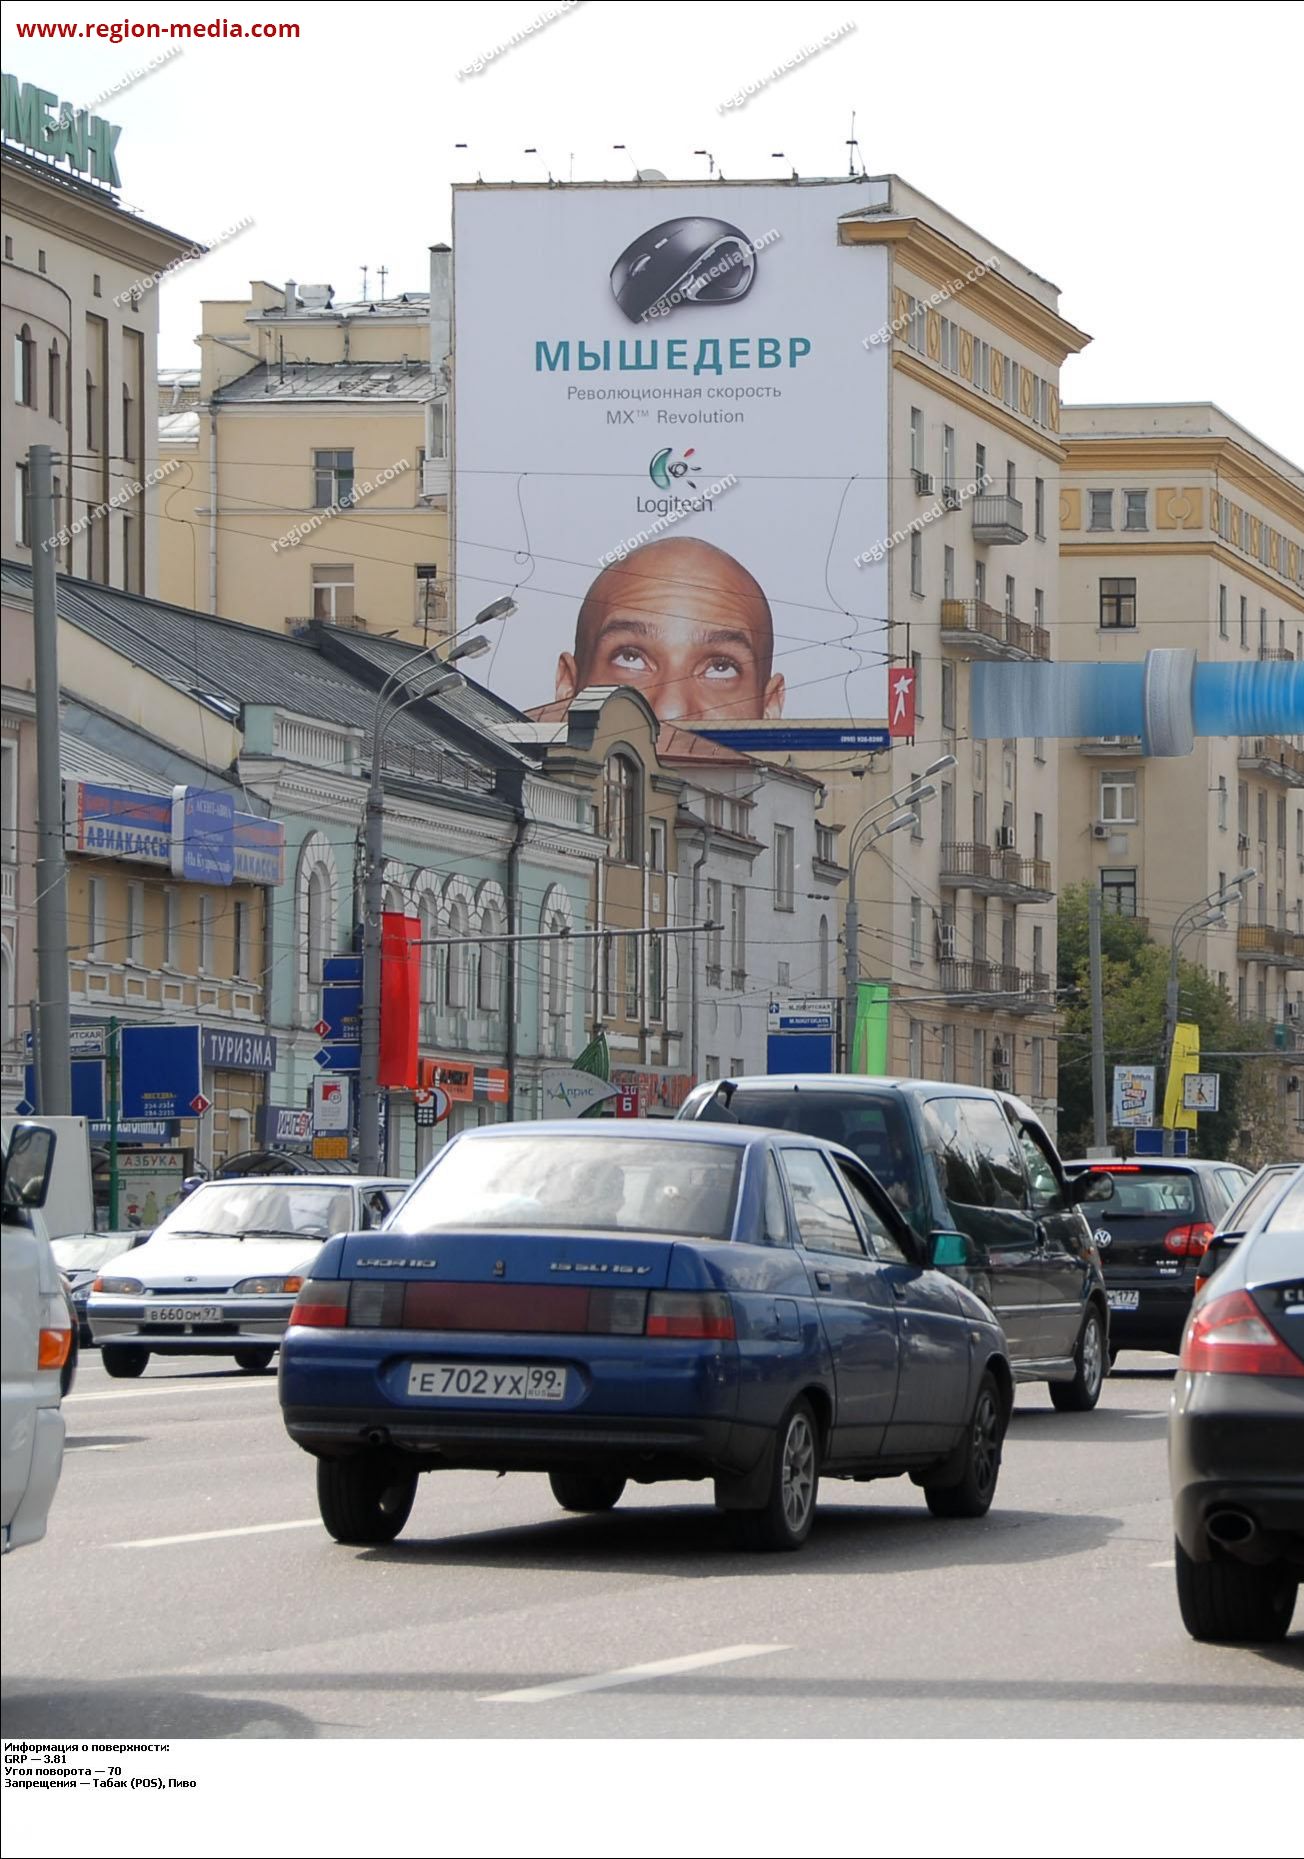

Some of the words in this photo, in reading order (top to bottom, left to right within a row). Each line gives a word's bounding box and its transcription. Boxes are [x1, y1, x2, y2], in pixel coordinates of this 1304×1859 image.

[535, 337, 811, 376] МЫШЕДЕВР
[568, 386, 702, 401] Революционная
[707, 386, 781, 401] скорость
[657, 409, 744, 425] Revolution
[636, 495, 712, 516] Logitech
[87, 826, 169, 857] АВИАКАССЫ
[211, 1035, 272, 1067] ТУРИЗМА
[124, 1156, 177, 1167] АЗБУКА
[151, 1308, 201, 1321] В660ОМ
[204, 1307, 217, 1317] 97
[420, 1367, 524, 1396] Е702УХ
[531, 1369, 557, 1389] 99
